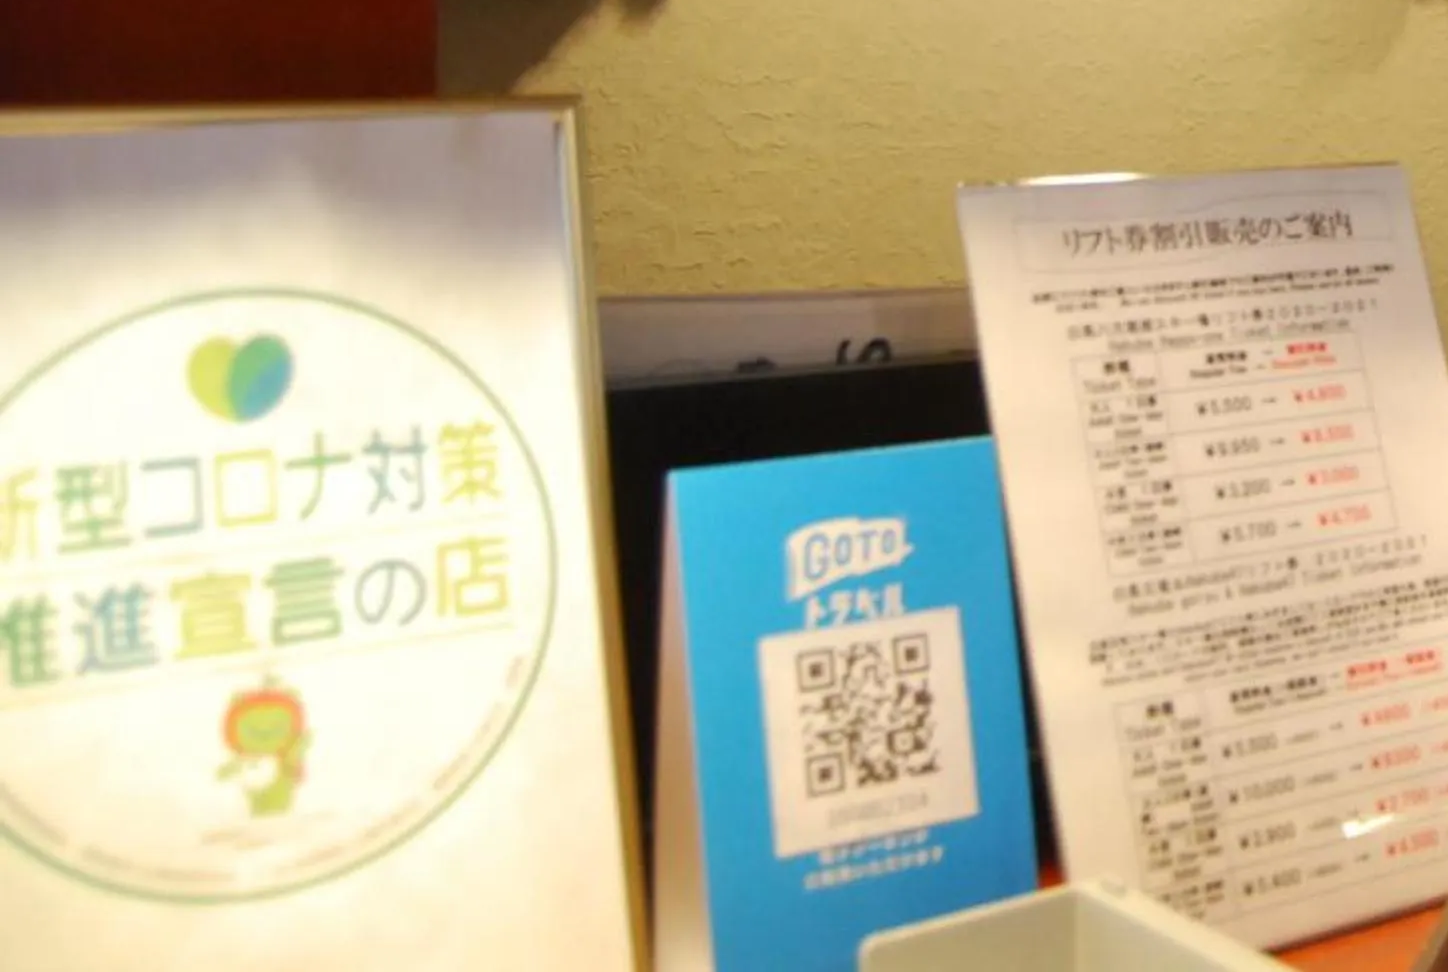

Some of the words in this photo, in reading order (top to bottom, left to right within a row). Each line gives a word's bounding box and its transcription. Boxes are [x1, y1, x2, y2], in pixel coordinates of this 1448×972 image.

[1062, 212, 1352, 257] リフト券割引販売のご案内
